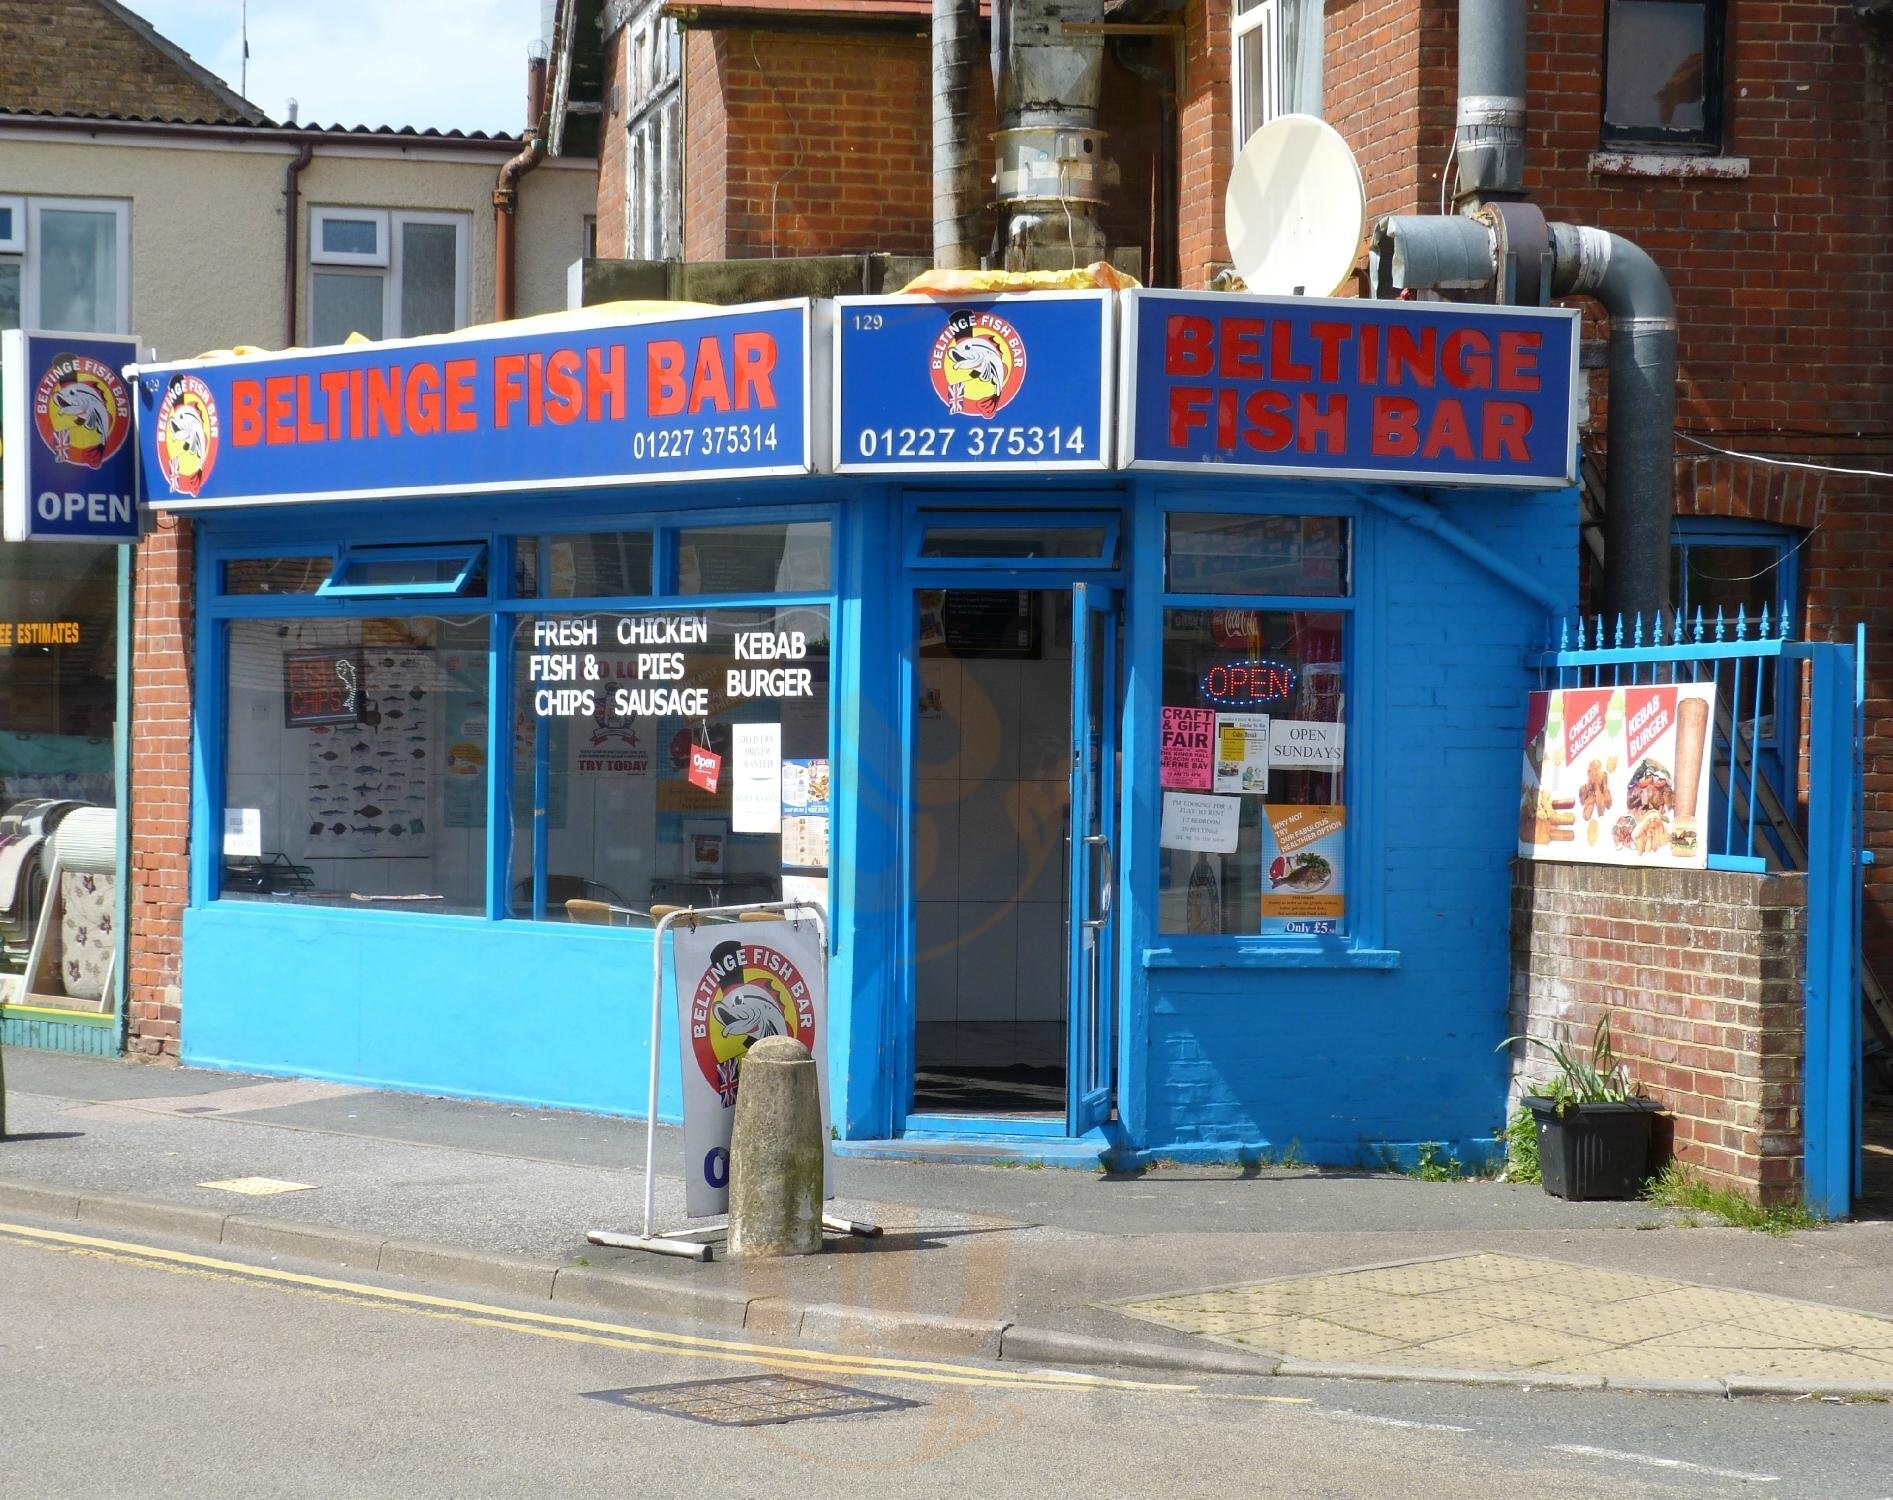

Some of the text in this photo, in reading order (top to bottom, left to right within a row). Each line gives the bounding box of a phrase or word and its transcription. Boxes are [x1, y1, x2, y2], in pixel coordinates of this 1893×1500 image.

[853, 314, 883, 331] 129
[932, 315, 1024, 370] BELTINGE FISH BAR
[1165, 314, 1543, 392] BELTINGE
[37, 359, 129, 418] BELTINGE FISH BAR
[231, 331, 777, 448] BELTINGE FISH BAR
[158, 379, 219, 442] BELTINGE FISH BAR
[1169, 386, 1533, 462] FISH BAR
[633, 424, 777, 460] 01227 375314
[859, 426, 1085, 457] 01227 375314
[37, 492, 131, 523] OPEN
[17, 622, 79, 644] ESTIMATES
[534, 620, 597, 646] FRESH
[617, 617, 707, 644] CHICKEN
[734, 632, 806, 660] KEBAB
[530, 654, 576, 681] FISH
[583, 654, 600, 680] &
[638, 652, 684, 680] PIES
[727, 669, 813, 697] BURGER
[1209, 667, 1288, 697] OPEN
[535, 689, 595, 716] CHIPS
[615, 688, 708, 716] SAUSAGE
[1163, 708, 1212, 721] CRAFT
[1628, 694, 1660, 736] KEBAB
[1162, 720, 1211, 732] & GIFT
[1290, 729, 1327, 741] OPEN
[1569, 702, 1600, 740] CHICKEN
[1629, 709, 1668, 758] BURGER
[1162, 732, 1208, 748] FAIR
[1570, 716, 1602, 758] SAUSAGE
[578, 760, 648, 771] TRY TODAY
[693, 753, 716, 769] Open
[1274, 745, 1341, 759] SUNDAYS
[1273, 812, 1303, 831] WHY NOT
[1275, 828, 1288, 838] TRY
[1280, 817, 1329, 844] OUR FABULOUS
[1281, 820, 1342, 853] HEALTHIER OPTION
[1286, 921, 1311, 934] Only
[693, 949, 813, 1038] BELTINGE FISH BAR
